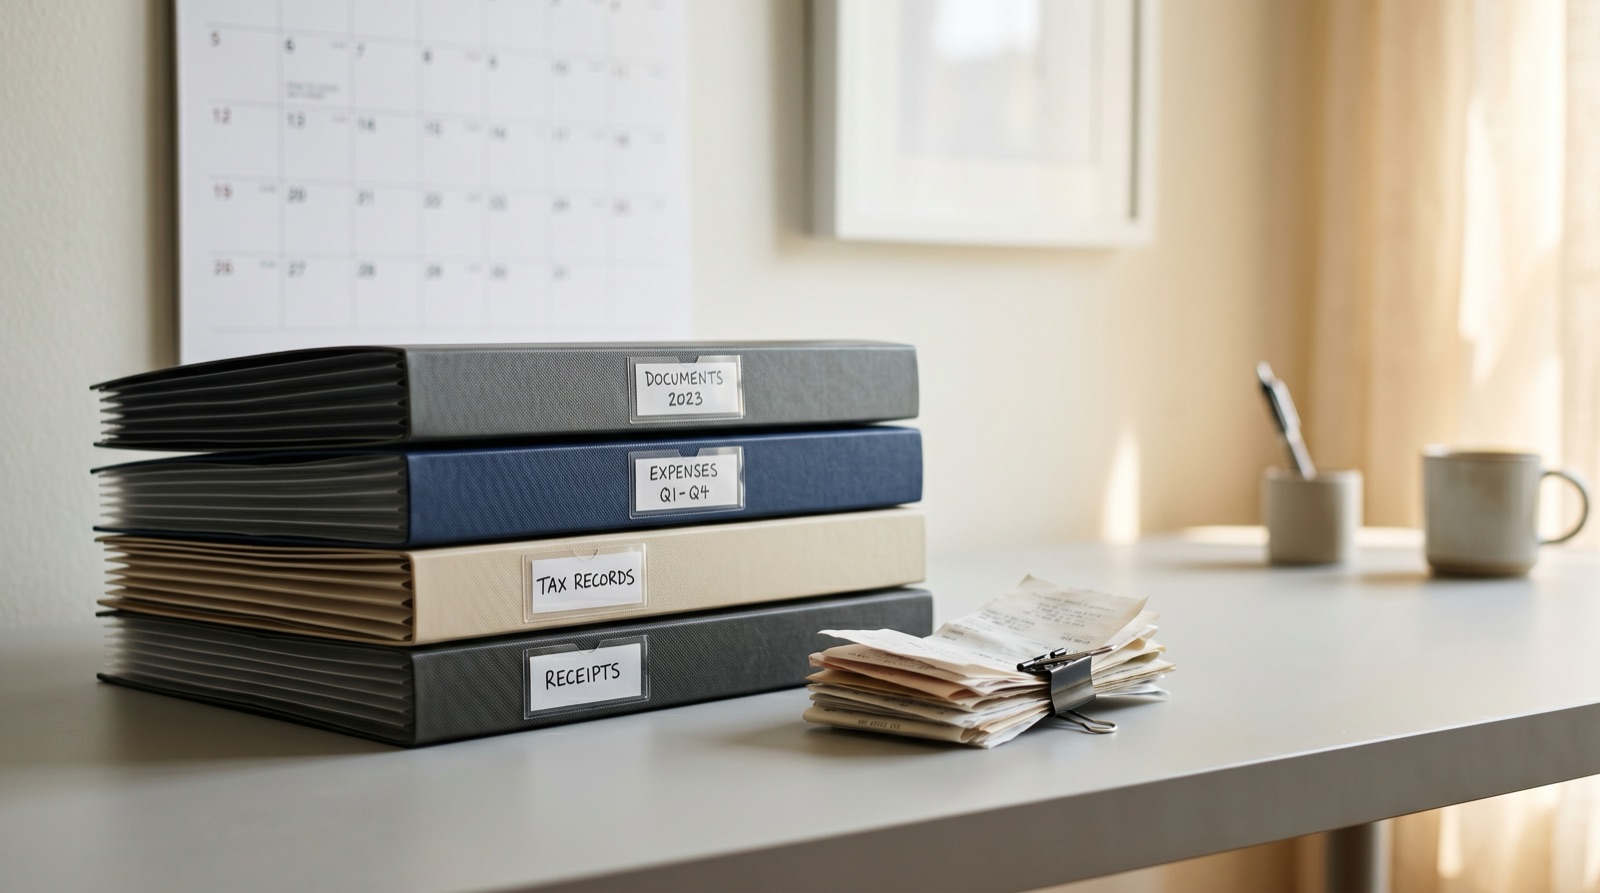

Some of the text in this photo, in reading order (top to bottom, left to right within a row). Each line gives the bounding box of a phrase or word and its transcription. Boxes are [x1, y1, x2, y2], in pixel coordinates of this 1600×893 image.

[284, 38, 296, 53] 6
[212, 107, 231, 124] 12
[287, 112, 305, 129] 13
[357, 117, 375, 132] 14
[213, 183, 232, 200] 19
[287, 187, 306, 204] 20
[357, 191, 374, 206] 21
[213, 260, 233, 276] 26
[288, 261, 306, 277] 27
[358, 263, 376, 278] 28
[645, 370, 723, 387] DOCUMENTS
[668, 391, 703, 407] 2023
[650, 463, 718, 481] EXPENSES
[536, 568, 635, 595] TAX RECORDS
[545, 662, 620, 690] RECEIPTS
